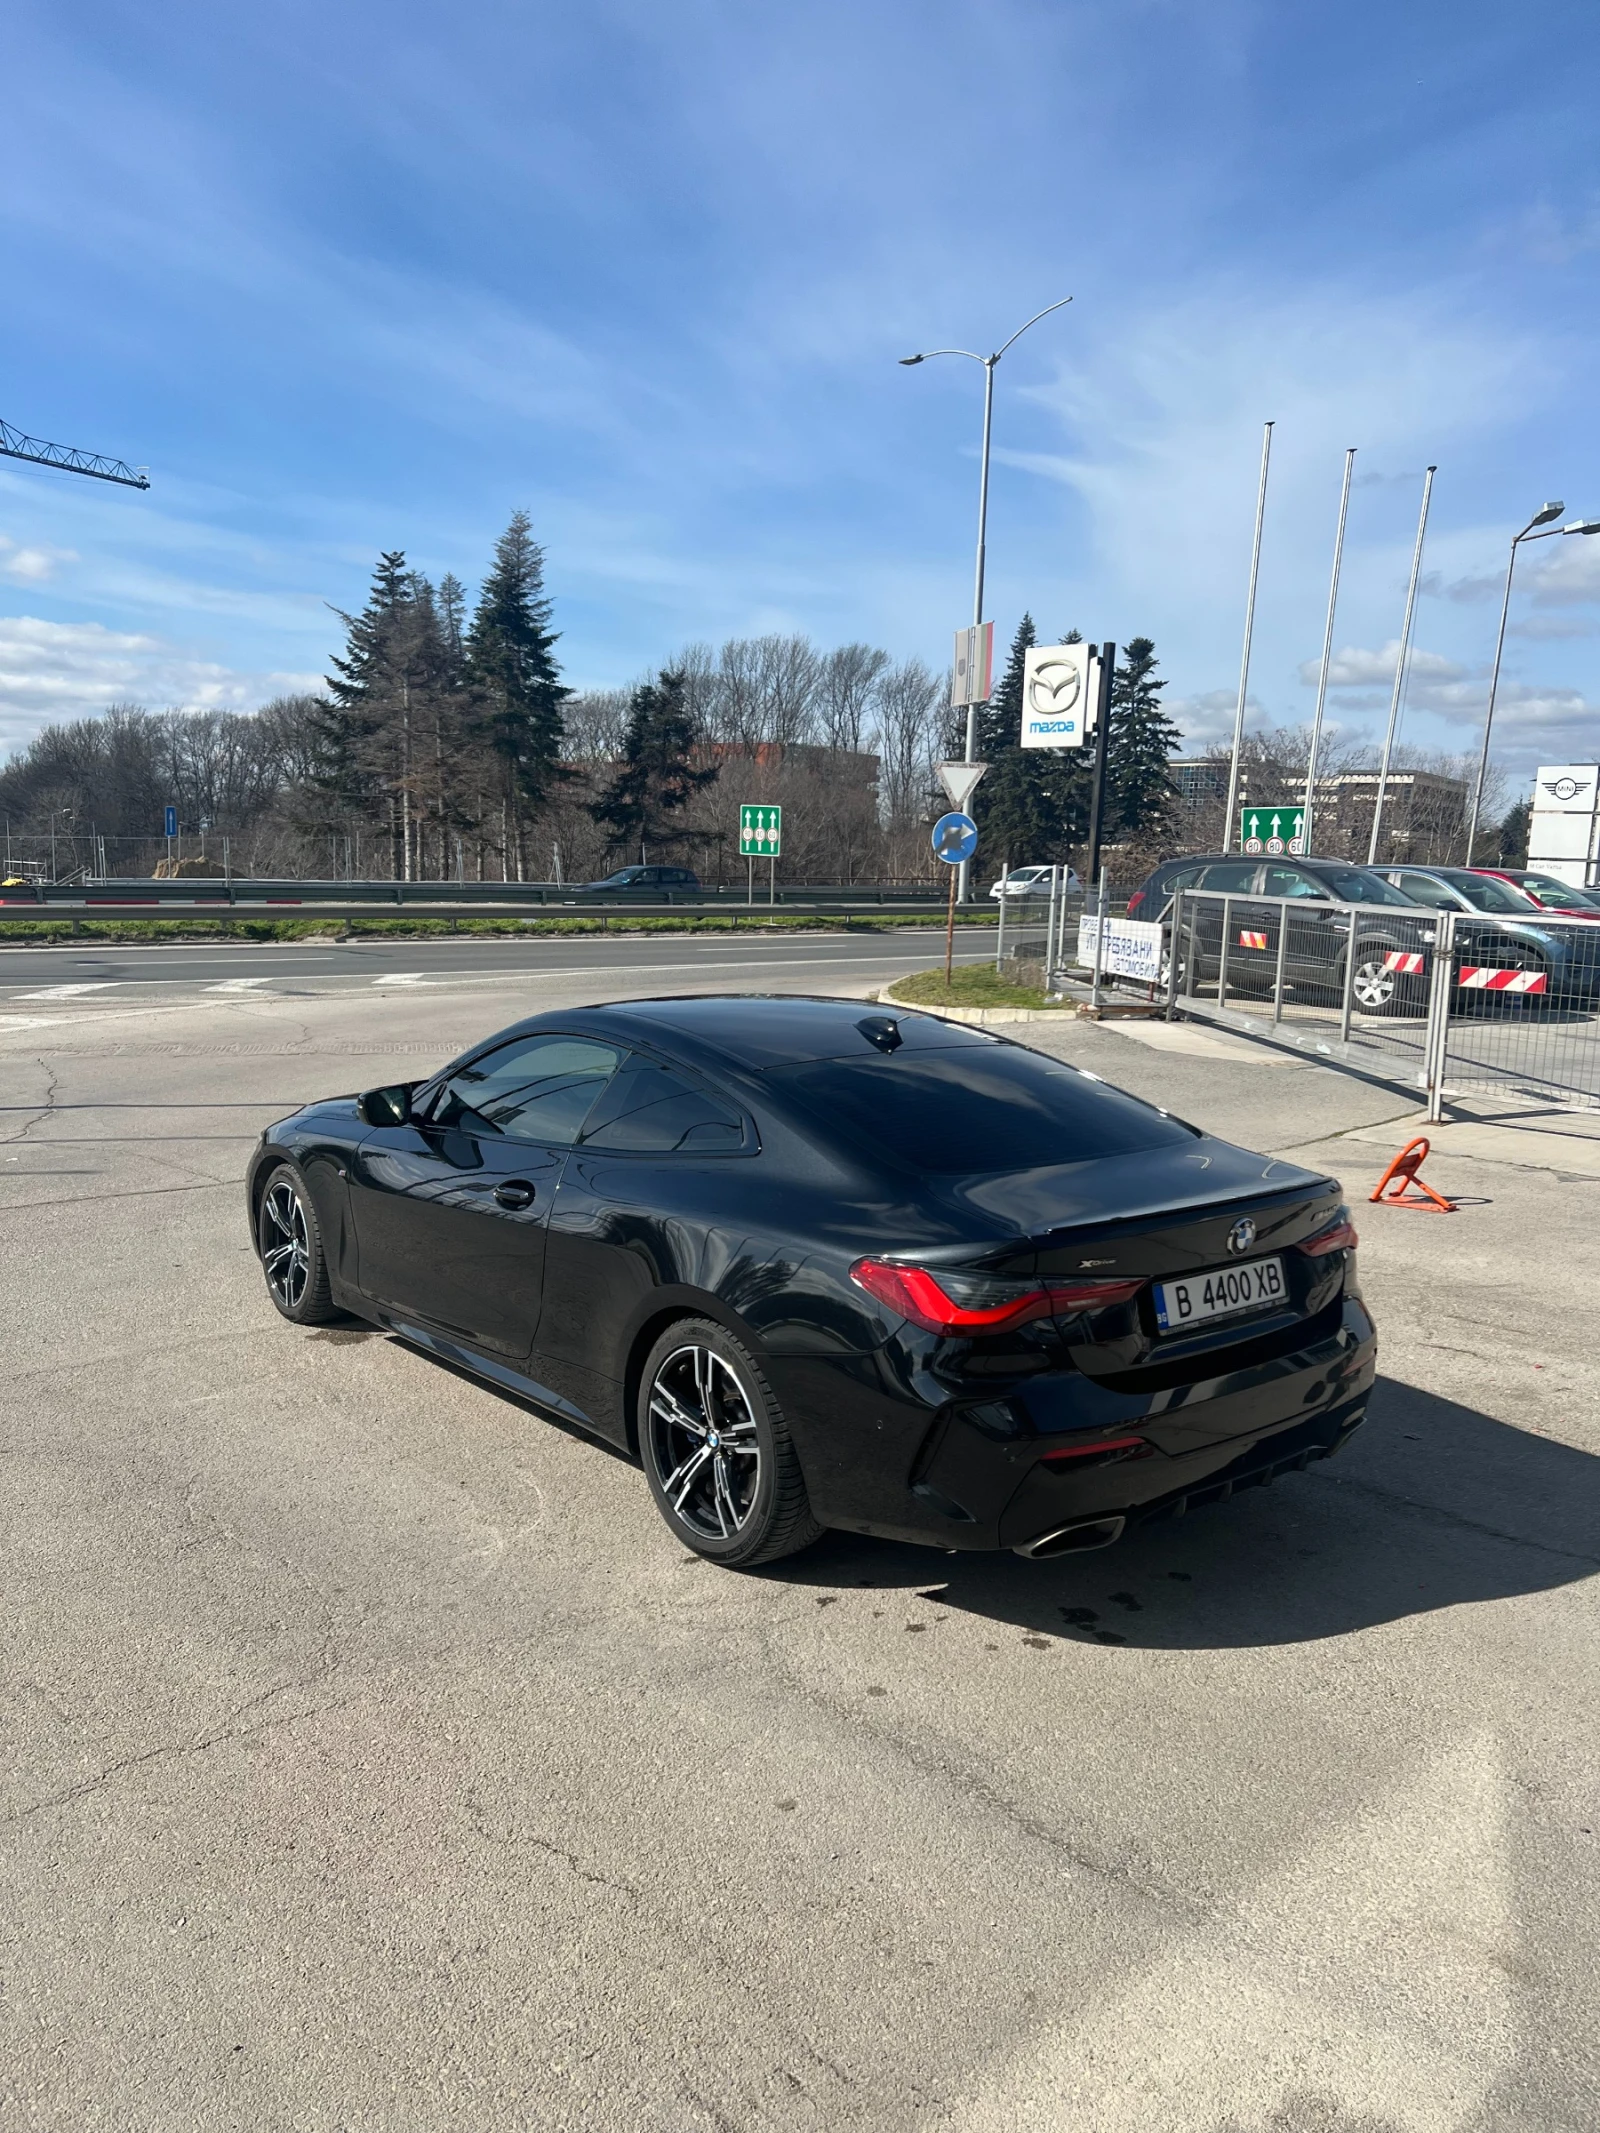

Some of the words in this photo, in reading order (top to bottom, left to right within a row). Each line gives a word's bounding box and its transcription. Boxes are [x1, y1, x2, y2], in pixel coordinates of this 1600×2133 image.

[1030, 720, 1075, 734] mazda
[1248, 841, 1259, 852] 80
[1269, 841, 1281, 852] 80
[1086, 933, 1152, 960] УПТРЕБЯВАНИ
[1175, 1285, 1192, 1318] B
[1203, 1270, 1251, 1311] 4400
[1253, 1263, 1281, 1298] XB
[1156, 1312, 1168, 1324] BG
